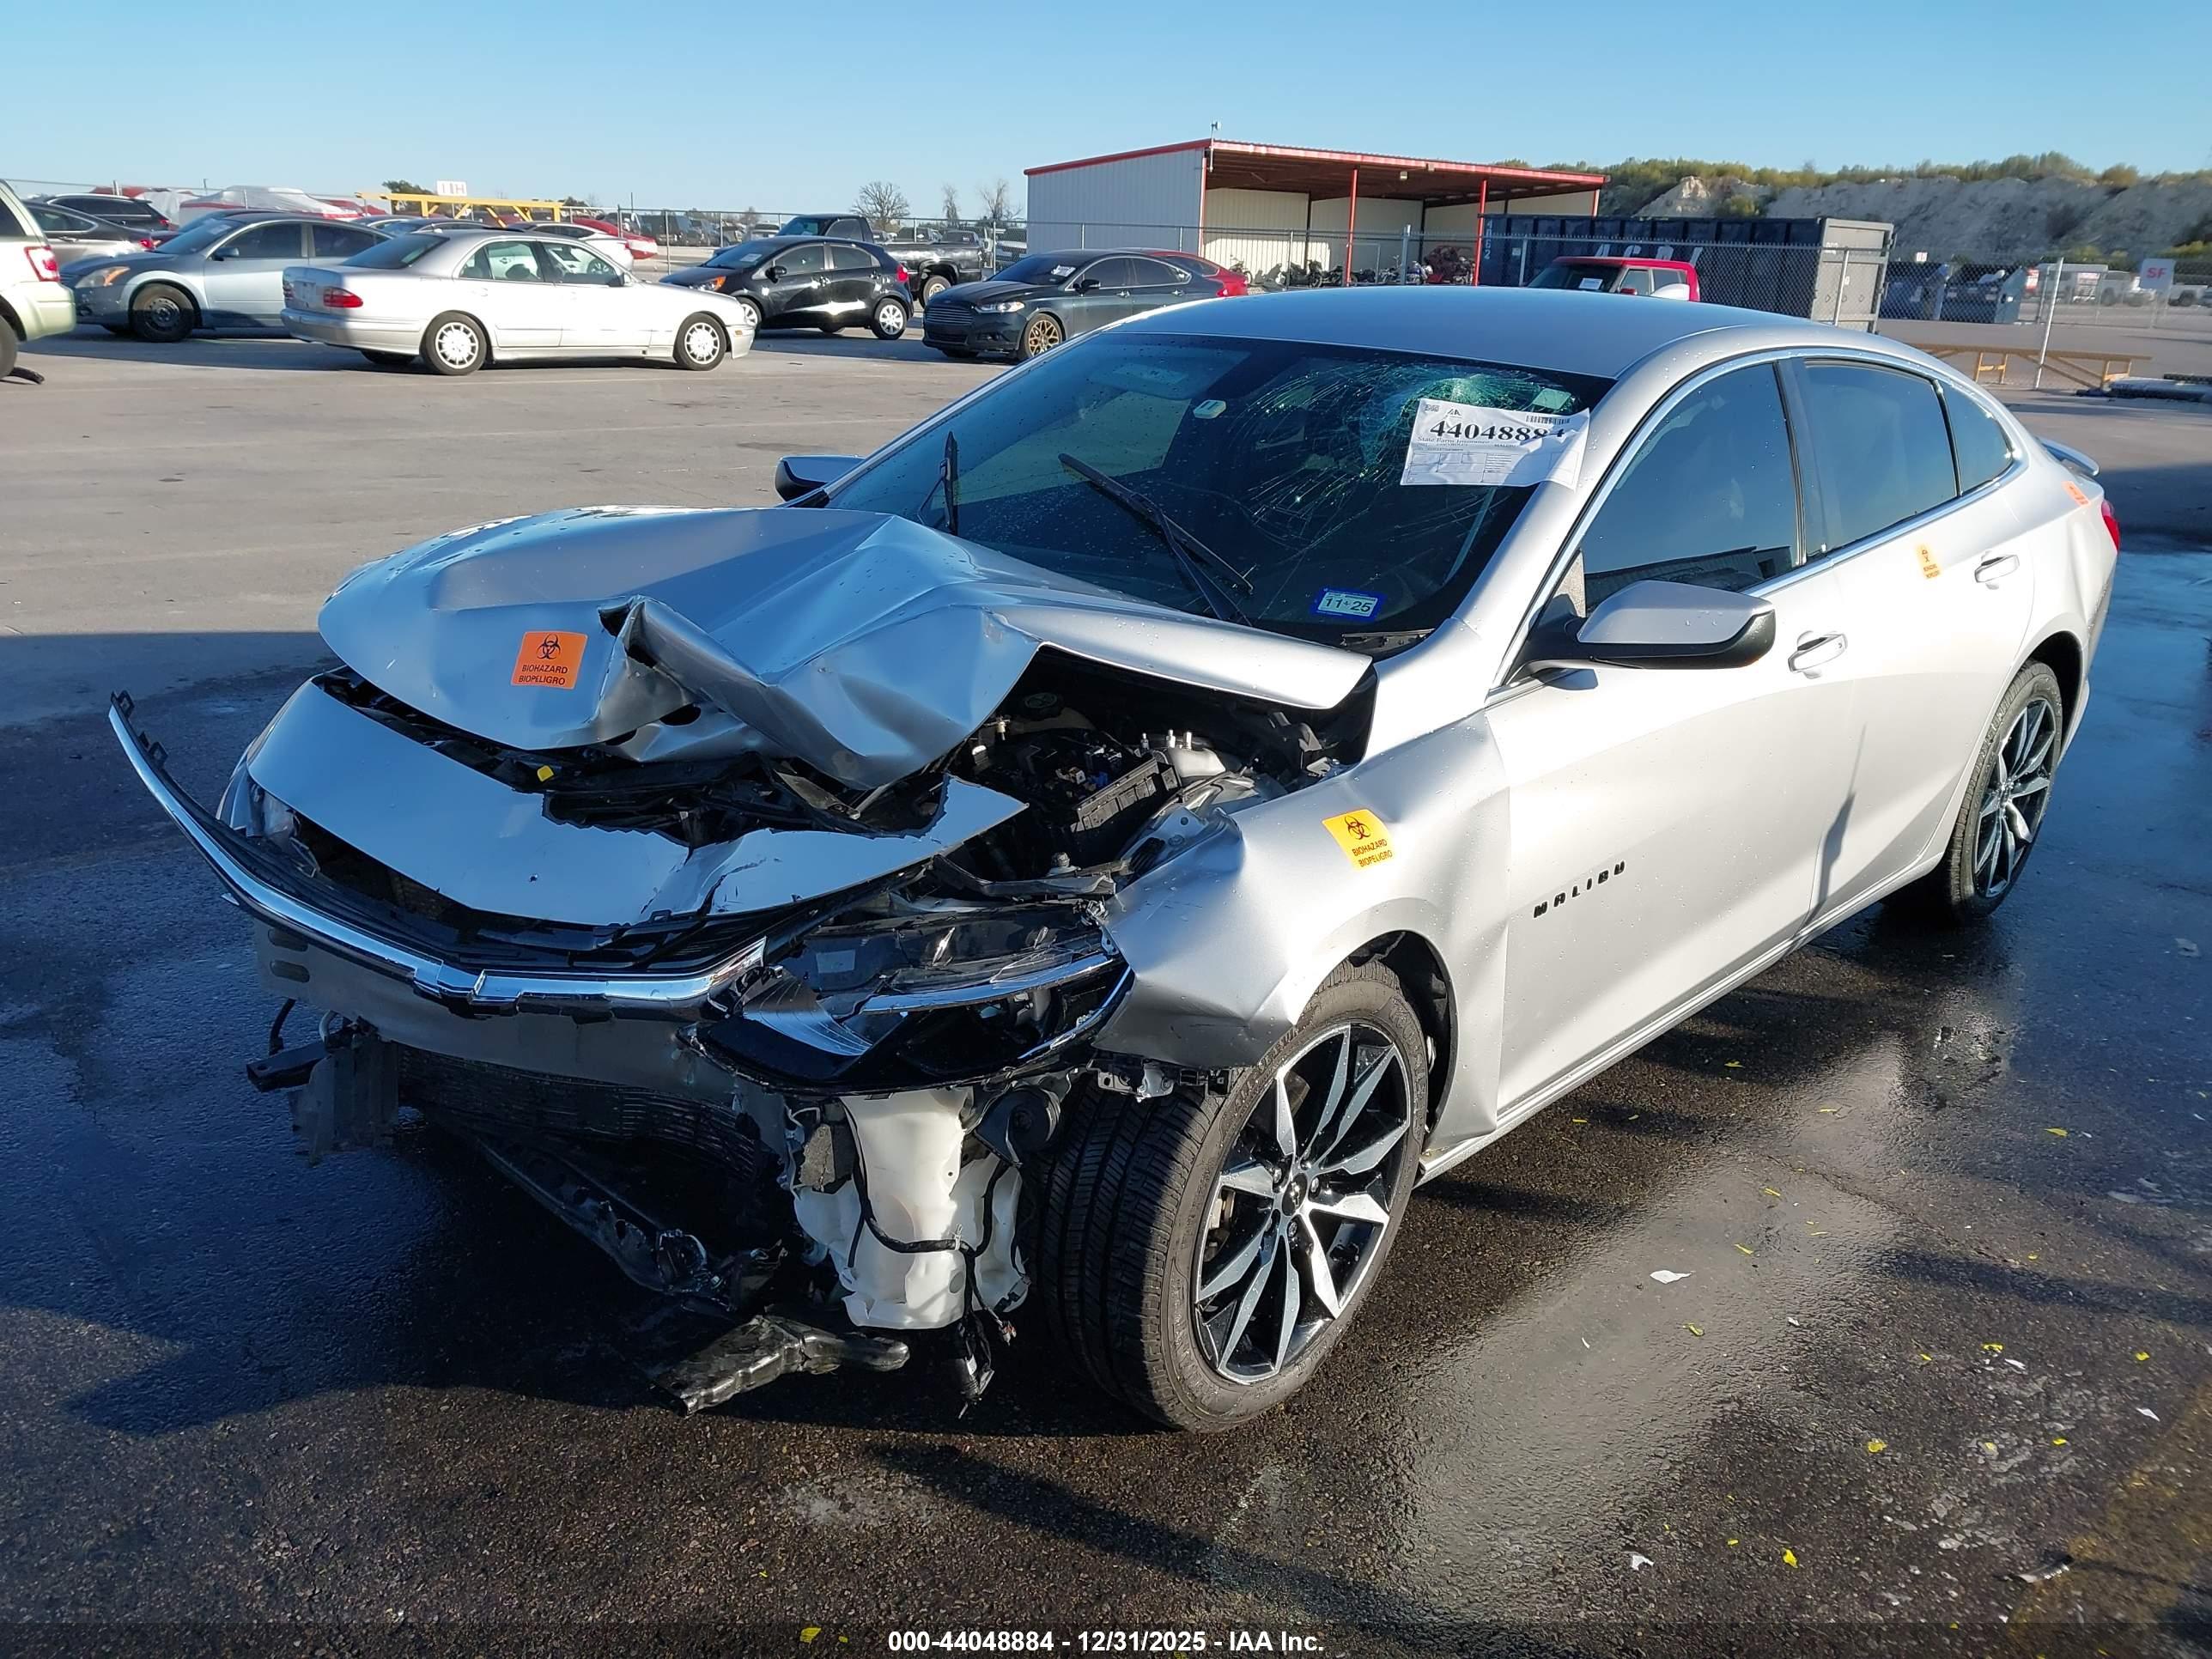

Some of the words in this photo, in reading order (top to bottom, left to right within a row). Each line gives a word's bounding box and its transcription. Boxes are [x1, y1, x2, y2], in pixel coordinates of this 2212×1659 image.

[2146, 267, 2168, 279] SF
[1350, 600, 1373, 612] 25
[521, 665, 568, 674] BIOHAZARD
[518, 675, 566, 685] BIOPELIGRO
[1351, 839, 1388, 857] BIOHAZARD
[1358, 850, 1393, 867] BIOPELIGRO
[1533, 860, 1626, 918] MALIBU
